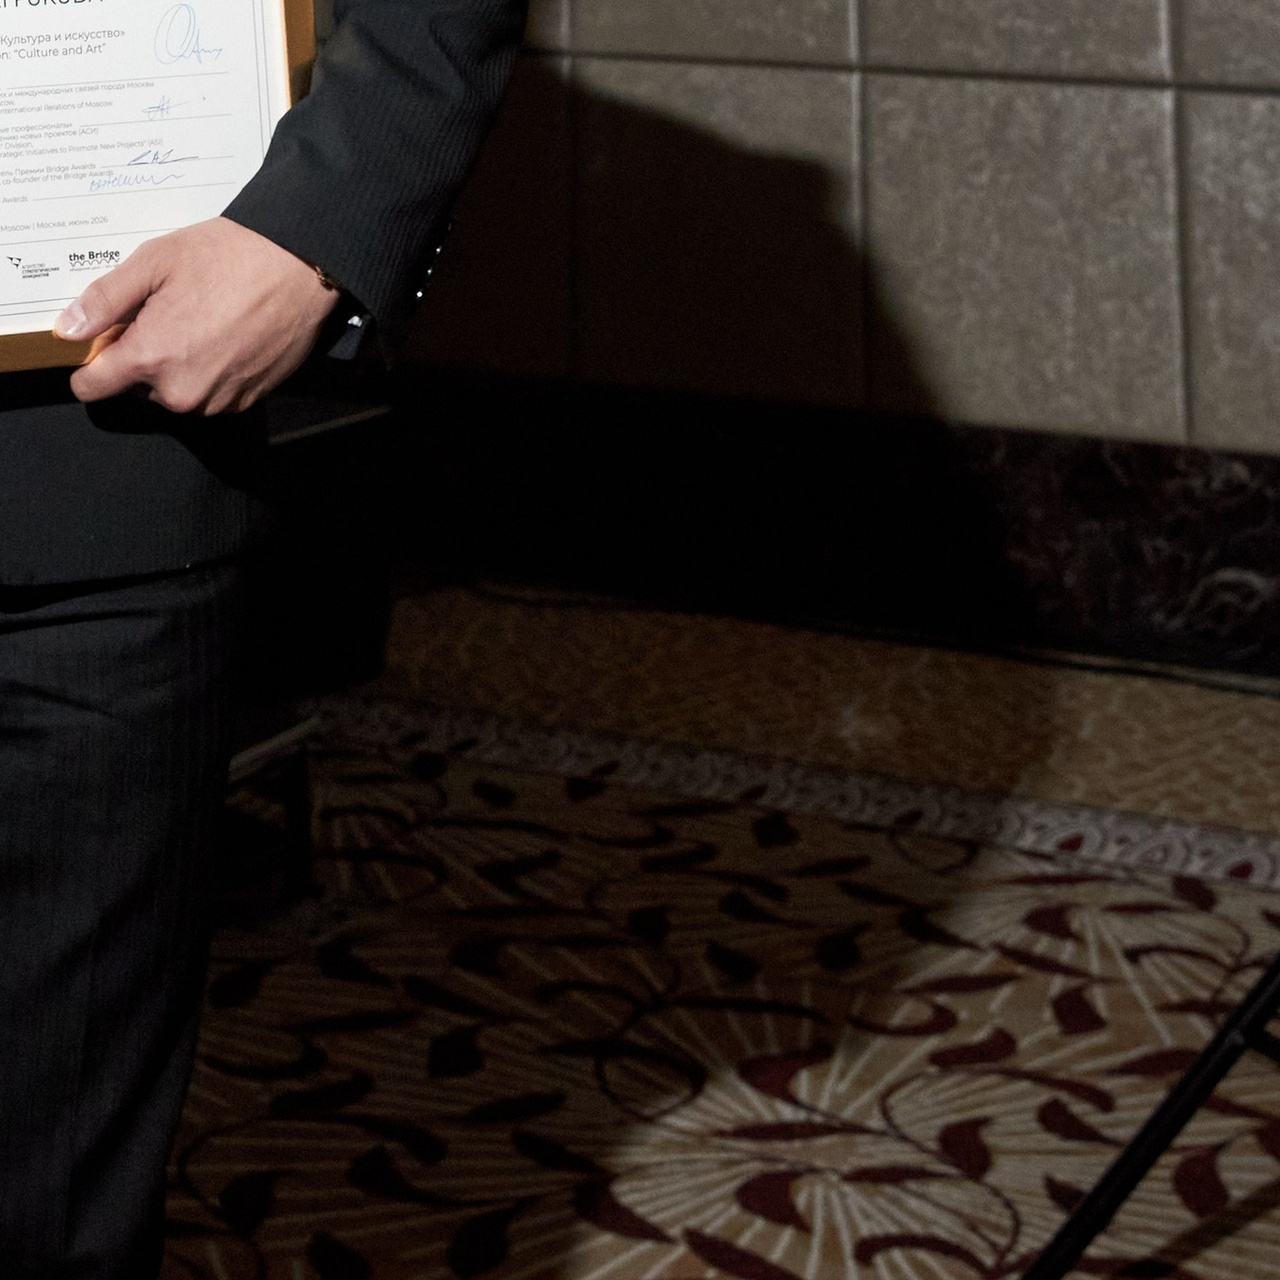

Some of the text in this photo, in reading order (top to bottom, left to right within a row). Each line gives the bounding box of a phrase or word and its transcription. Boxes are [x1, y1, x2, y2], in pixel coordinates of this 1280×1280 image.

[54, 34, 61, 42] и
[64, 30, 125, 42] искусство»
[61, 44, 82, 56] and
[69, 250, 120, 261] the Bridge
